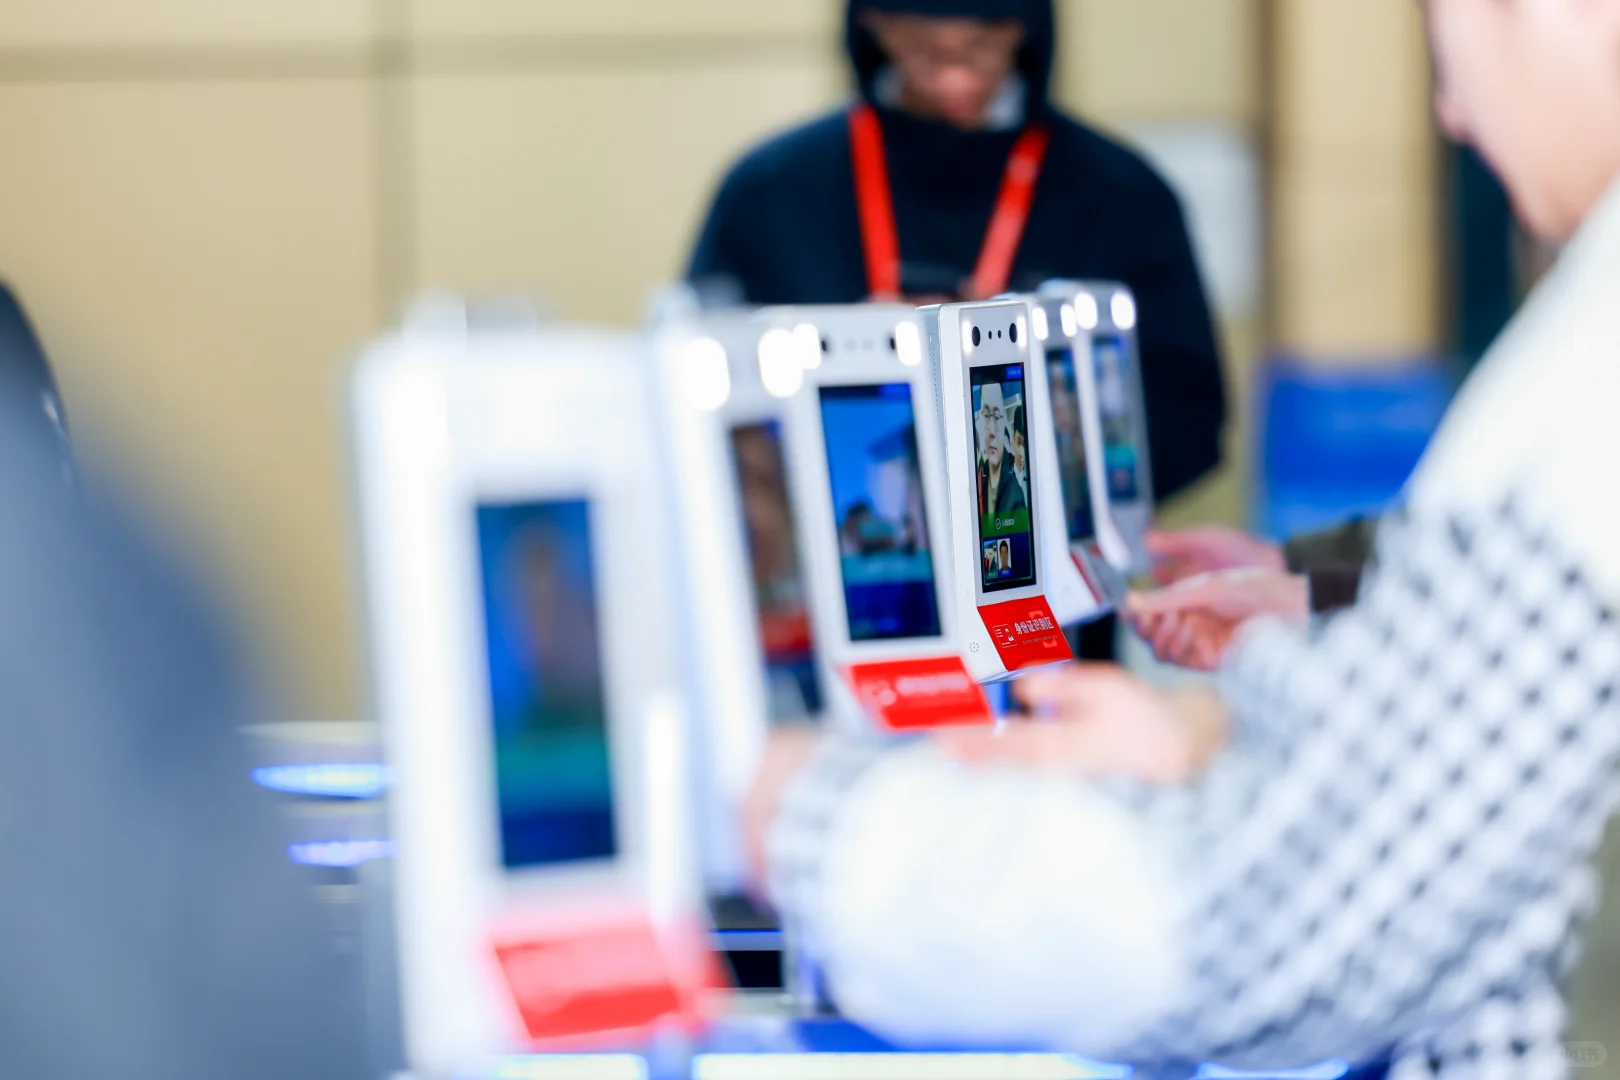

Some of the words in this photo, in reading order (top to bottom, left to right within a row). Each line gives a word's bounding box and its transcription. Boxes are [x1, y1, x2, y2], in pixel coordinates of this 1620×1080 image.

[1014, 616, 1055, 635] 身份证识别区
